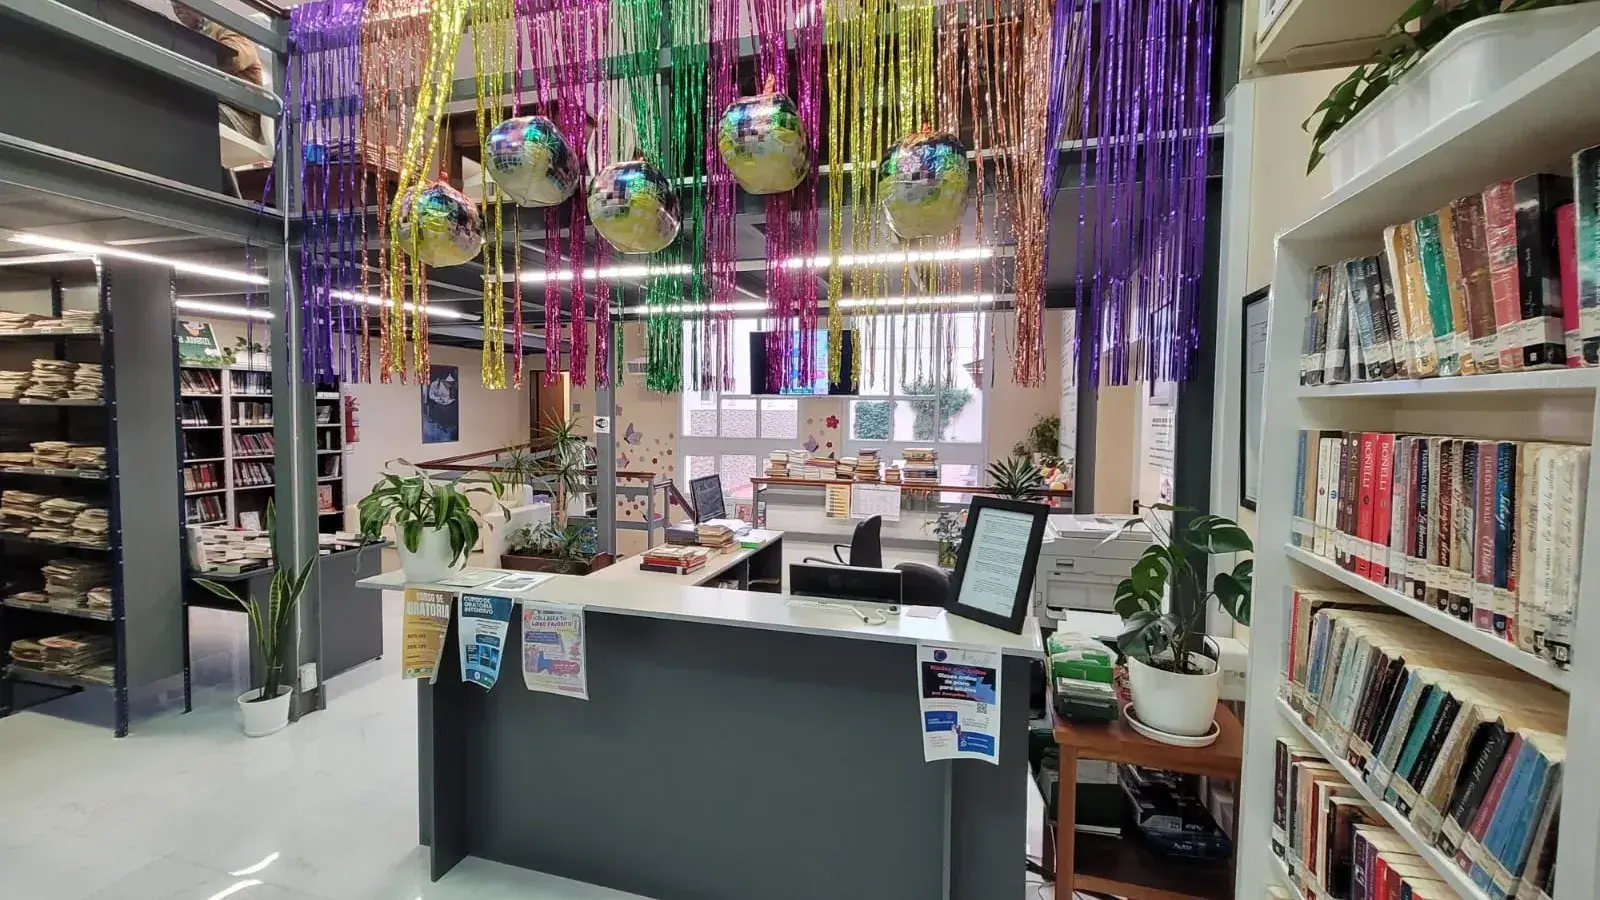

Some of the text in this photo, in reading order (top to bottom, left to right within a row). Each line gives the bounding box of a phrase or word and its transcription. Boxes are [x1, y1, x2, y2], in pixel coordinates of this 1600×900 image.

[1363, 441, 1372, 488] BONELLI
[1380, 442, 1389, 490] BONELLI
[1484, 456, 1492, 494] FLORENCIA
[1440, 495, 1450, 532] Sangre
[1418, 525, 1427, 557] libertina
[407, 602, 450, 618] ORATORIA
[416, 592, 444, 603] CURSO DE
